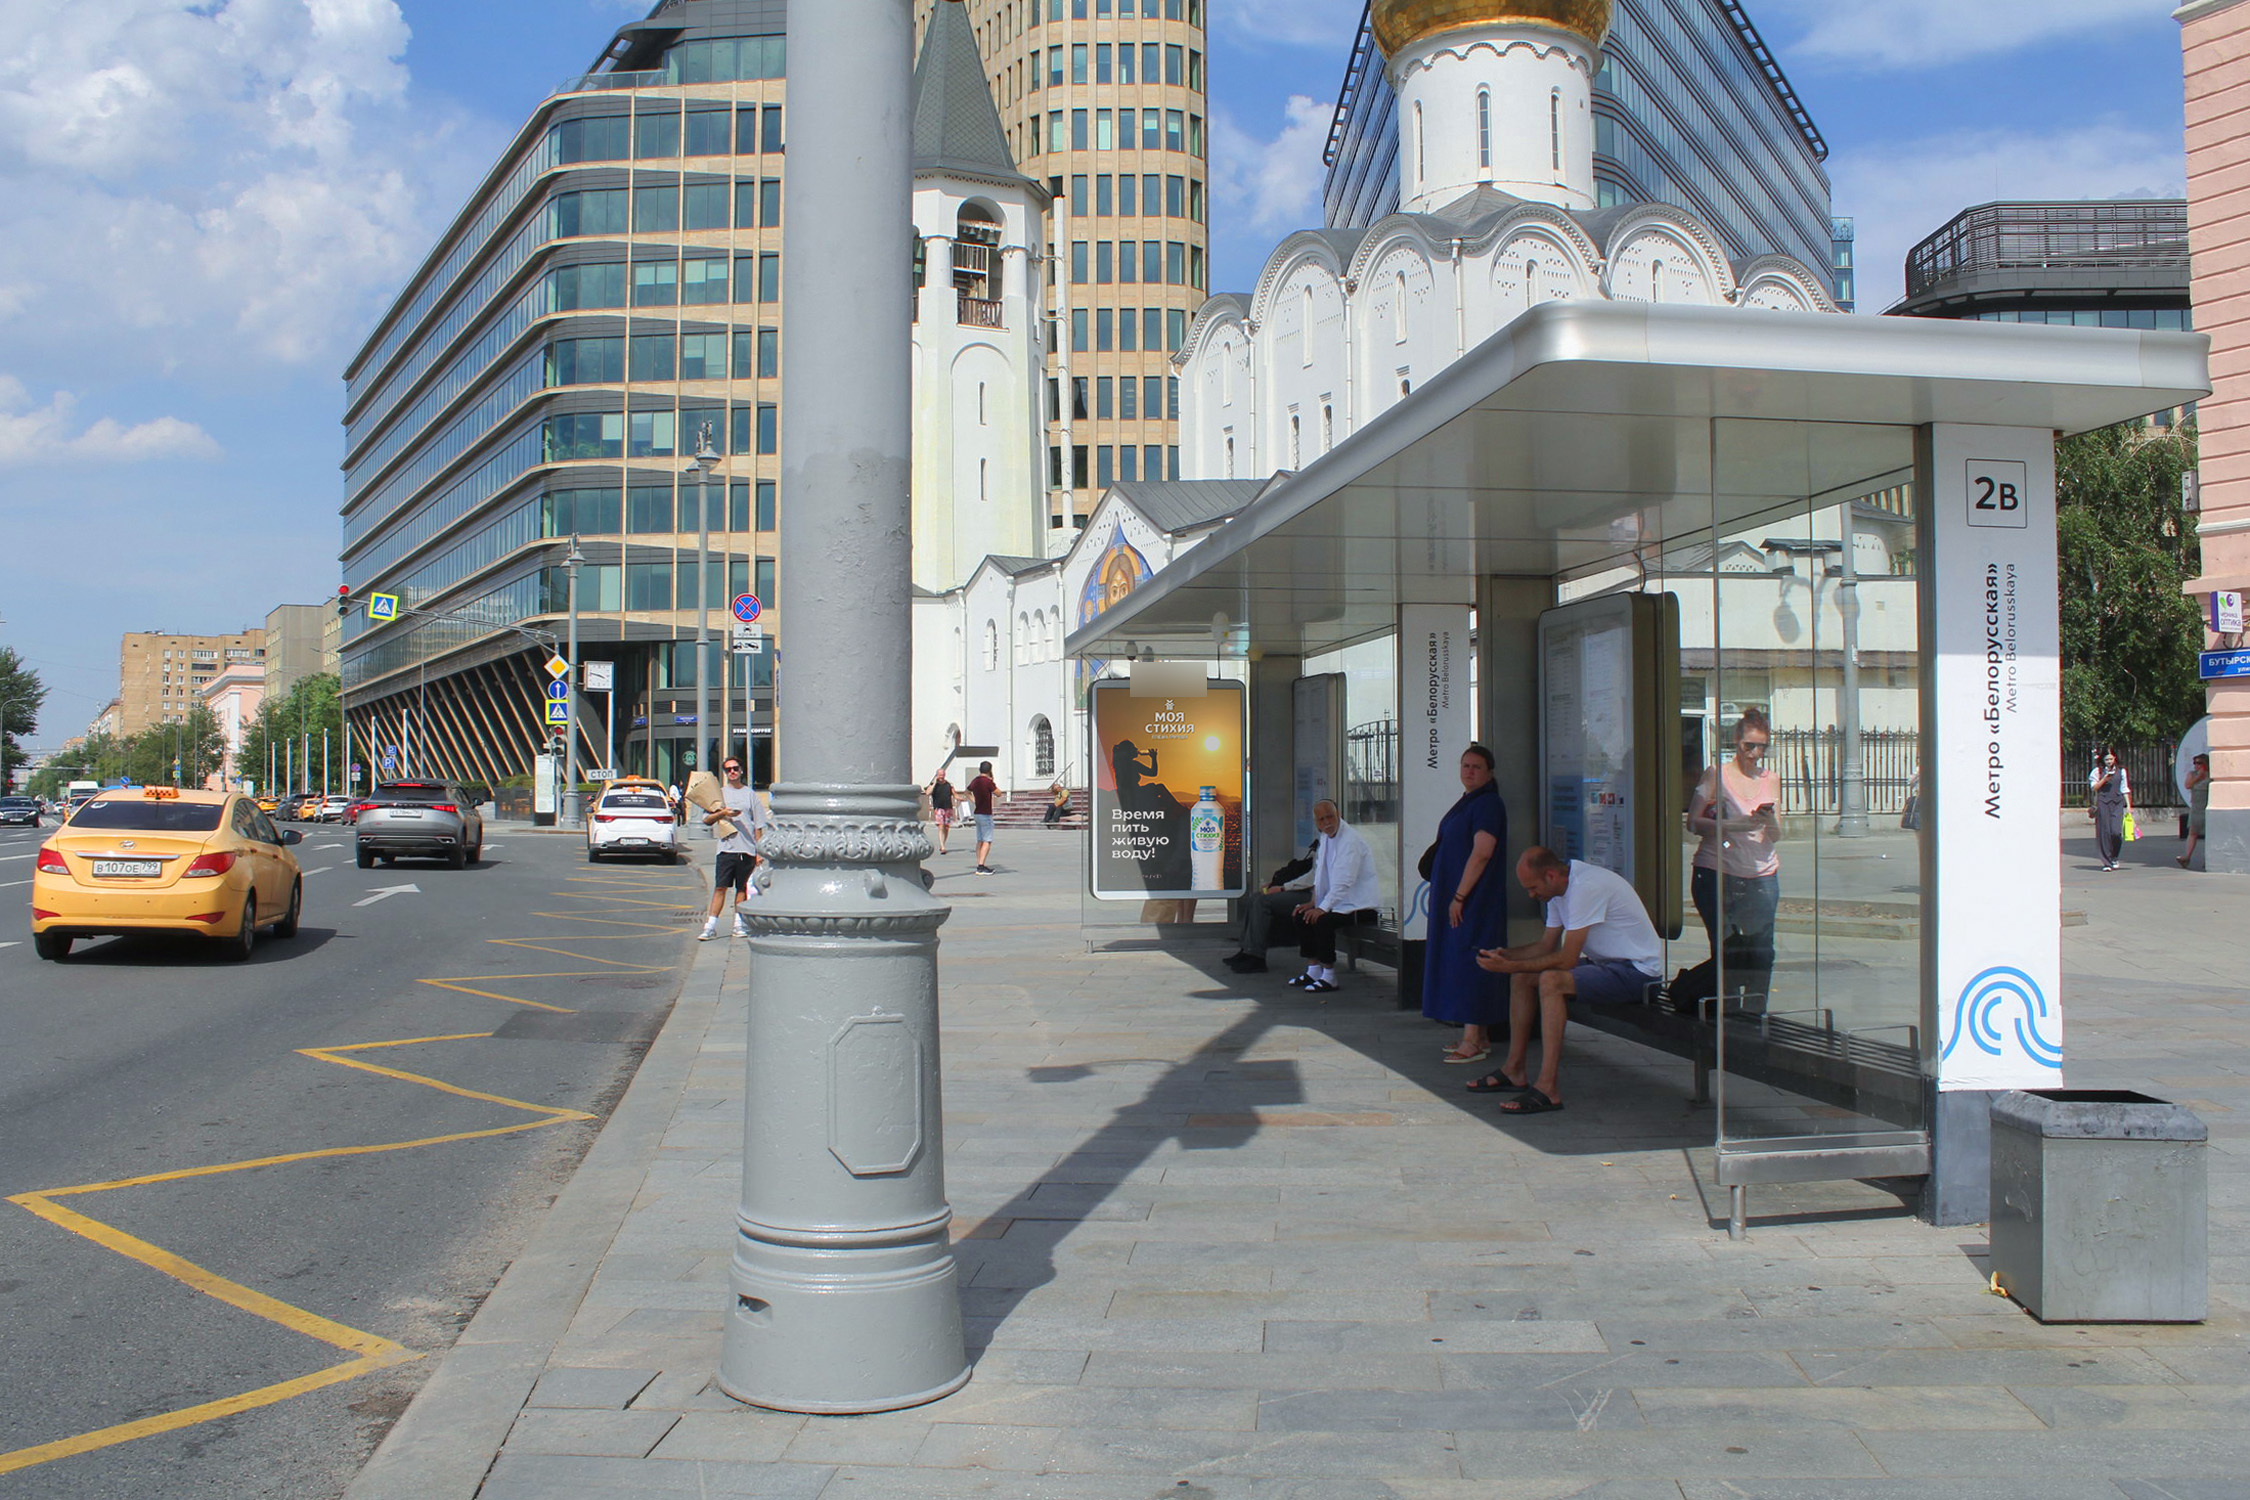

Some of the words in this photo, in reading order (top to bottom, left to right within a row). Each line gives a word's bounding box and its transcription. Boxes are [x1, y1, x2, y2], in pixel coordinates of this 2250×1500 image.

[2004, 563, 2018, 662] Belorusskaya
[1442, 631, 1450, 683] Belorusskaya
[1984, 563, 2003, 734] «Белорусская»
[1427, 632, 1440, 724] «Белорусская»
[2005, 666, 2017, 714] Metro
[1145, 723, 1194, 734] СТИХИЯ
[1155, 712, 1185, 722] МОЯ
[1427, 728, 1440, 769] Метро
[590, 770, 614, 778] СТОП
[1985, 741, 2004, 819] Метро
[1111, 809, 1165, 821] Время
[1111, 823, 1150, 833] пить
[1111, 836, 1170, 848] живую
[1111, 847, 1156, 860] воду!
